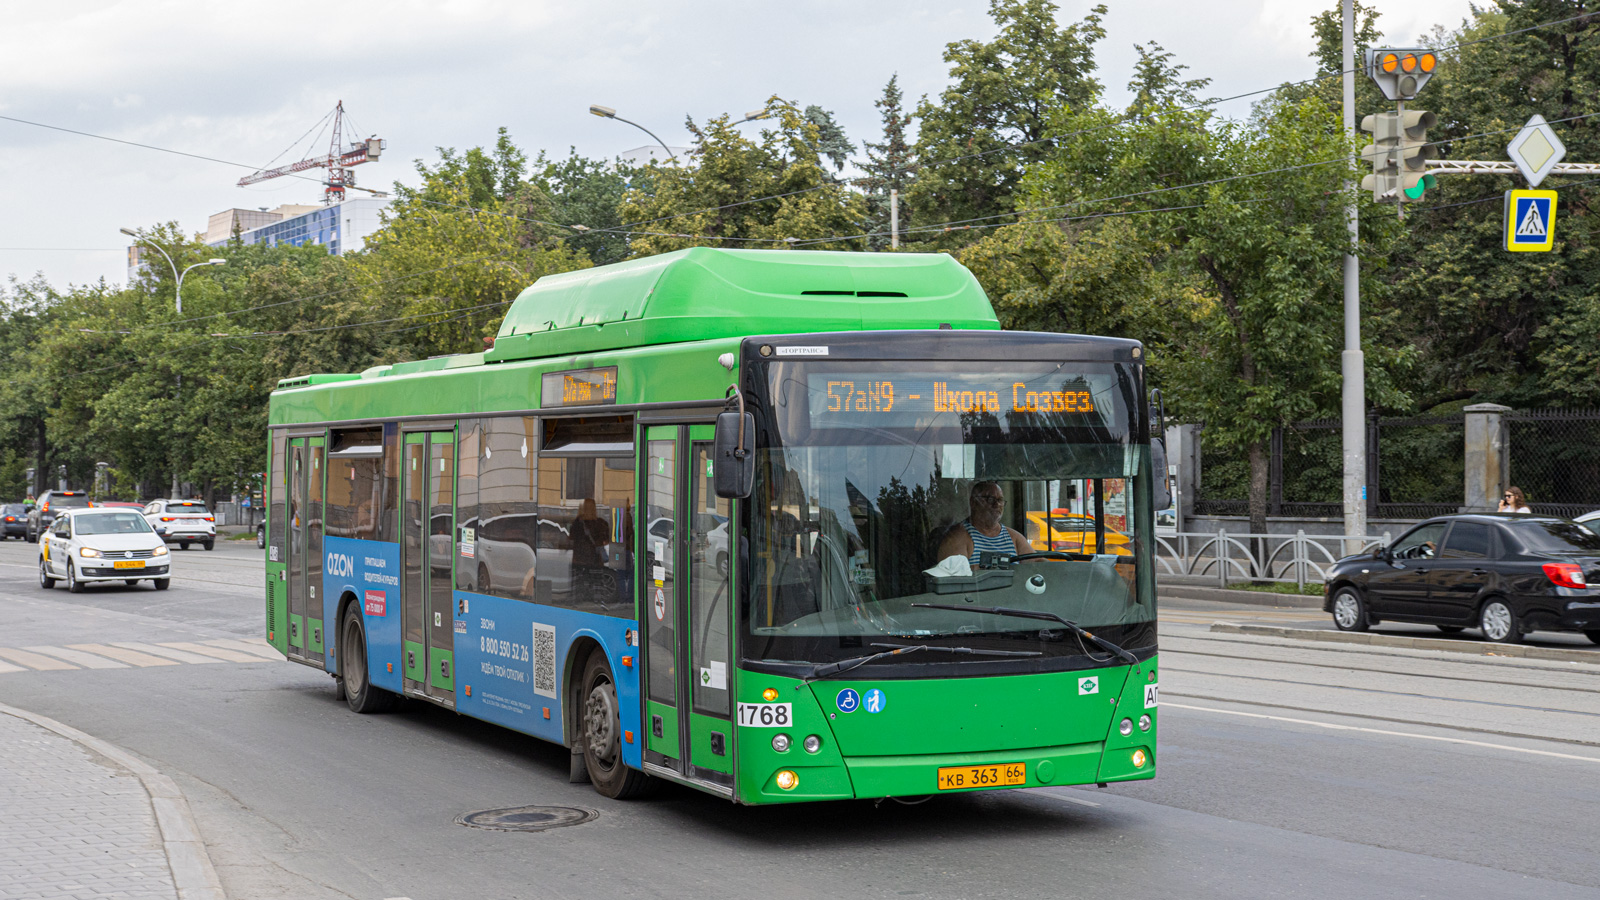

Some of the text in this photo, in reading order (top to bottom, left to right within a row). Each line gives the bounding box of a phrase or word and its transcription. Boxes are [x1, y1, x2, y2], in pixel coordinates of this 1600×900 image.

[933, 381, 1000, 412] Школа
[1012, 382, 1094, 412] Созвез
[328, 552, 354, 578] OZON
[480, 618, 495, 631] ЗВОНИ
[480, 636, 529, 662] 8 800 550 52 26
[480, 661, 524, 683] ЖДЁМ ТВОЙ ОТКЛИК
[738, 704, 788, 726] 1768
[947, 774, 964, 786] КВ
[971, 768, 998, 784] 363
[1006, 766, 1020, 778] 66
